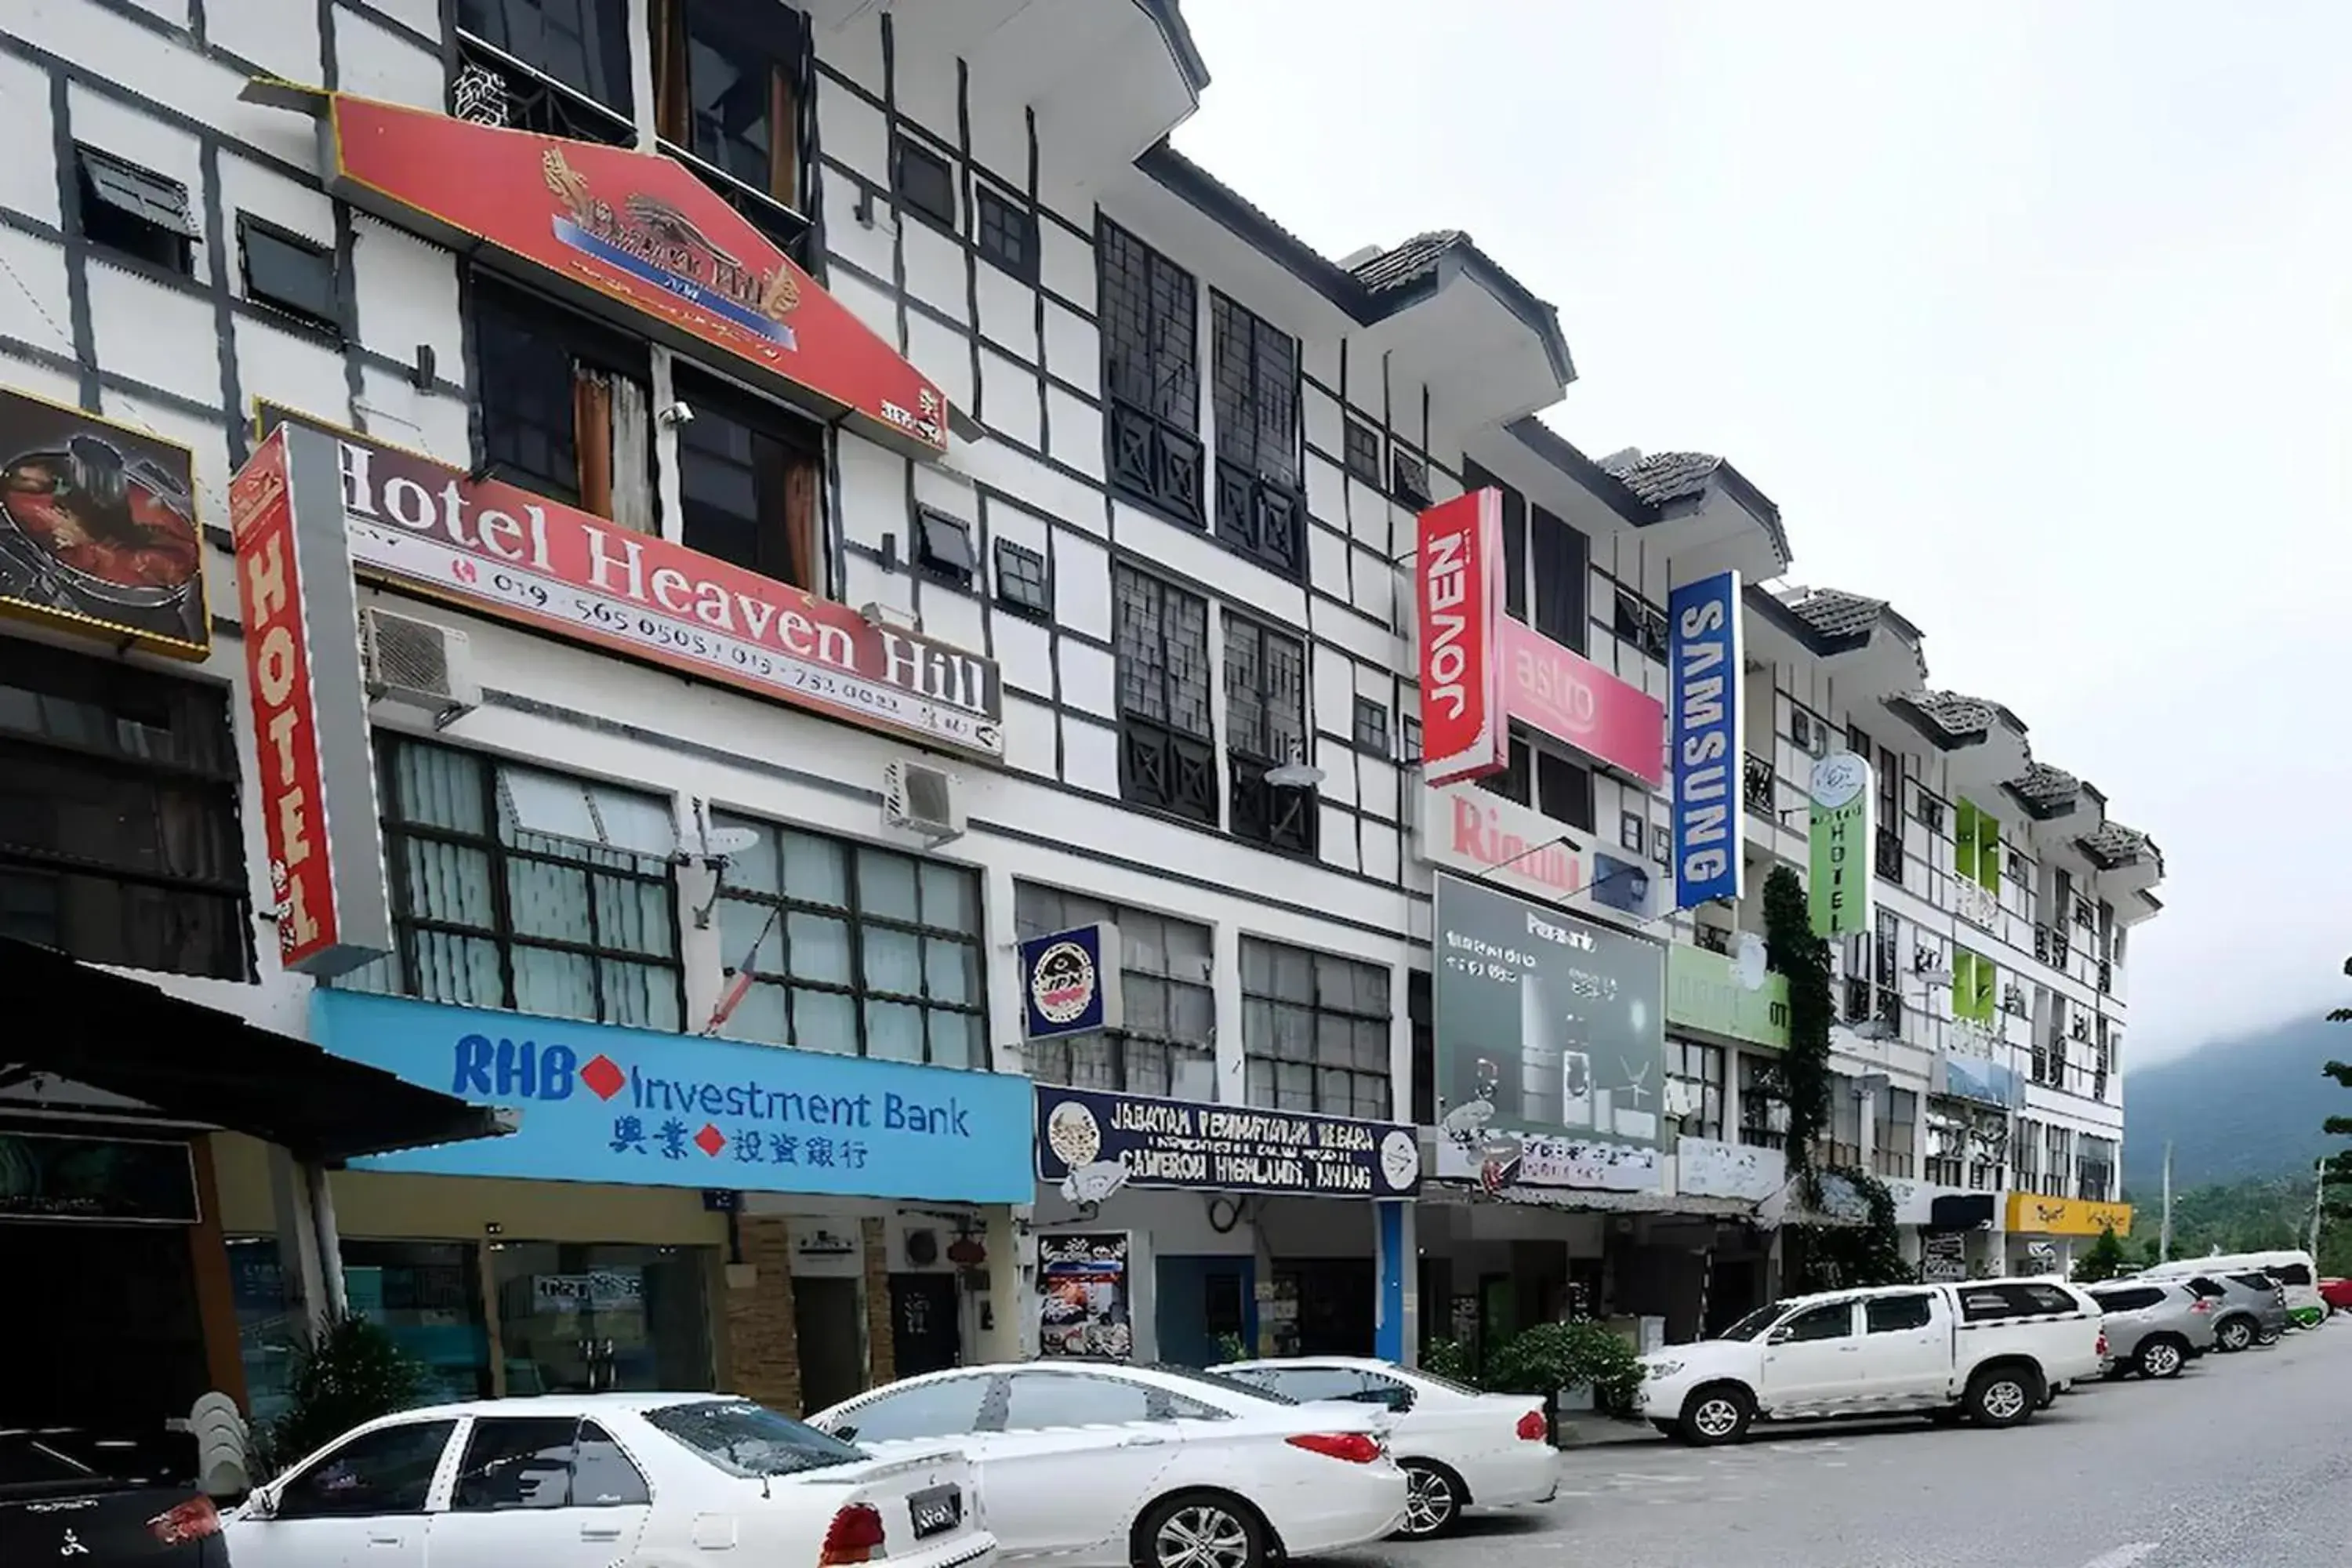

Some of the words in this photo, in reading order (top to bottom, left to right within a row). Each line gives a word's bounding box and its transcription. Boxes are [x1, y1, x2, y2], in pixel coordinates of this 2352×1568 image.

[339, 441, 555, 573] Hotel
[581, 524, 861, 673] Heaven
[879, 628, 989, 715] Hill
[1428, 532, 1466, 720] JOVEN
[249, 529, 319, 946] HOTEL
[1681, 599, 1727, 882] SAMSUNG
[1831, 823, 1846, 933] HOTEL
[452, 1034, 577, 1101] RHB
[632, 1065, 873, 1129] Investment
[884, 1091, 971, 1138] Bank
